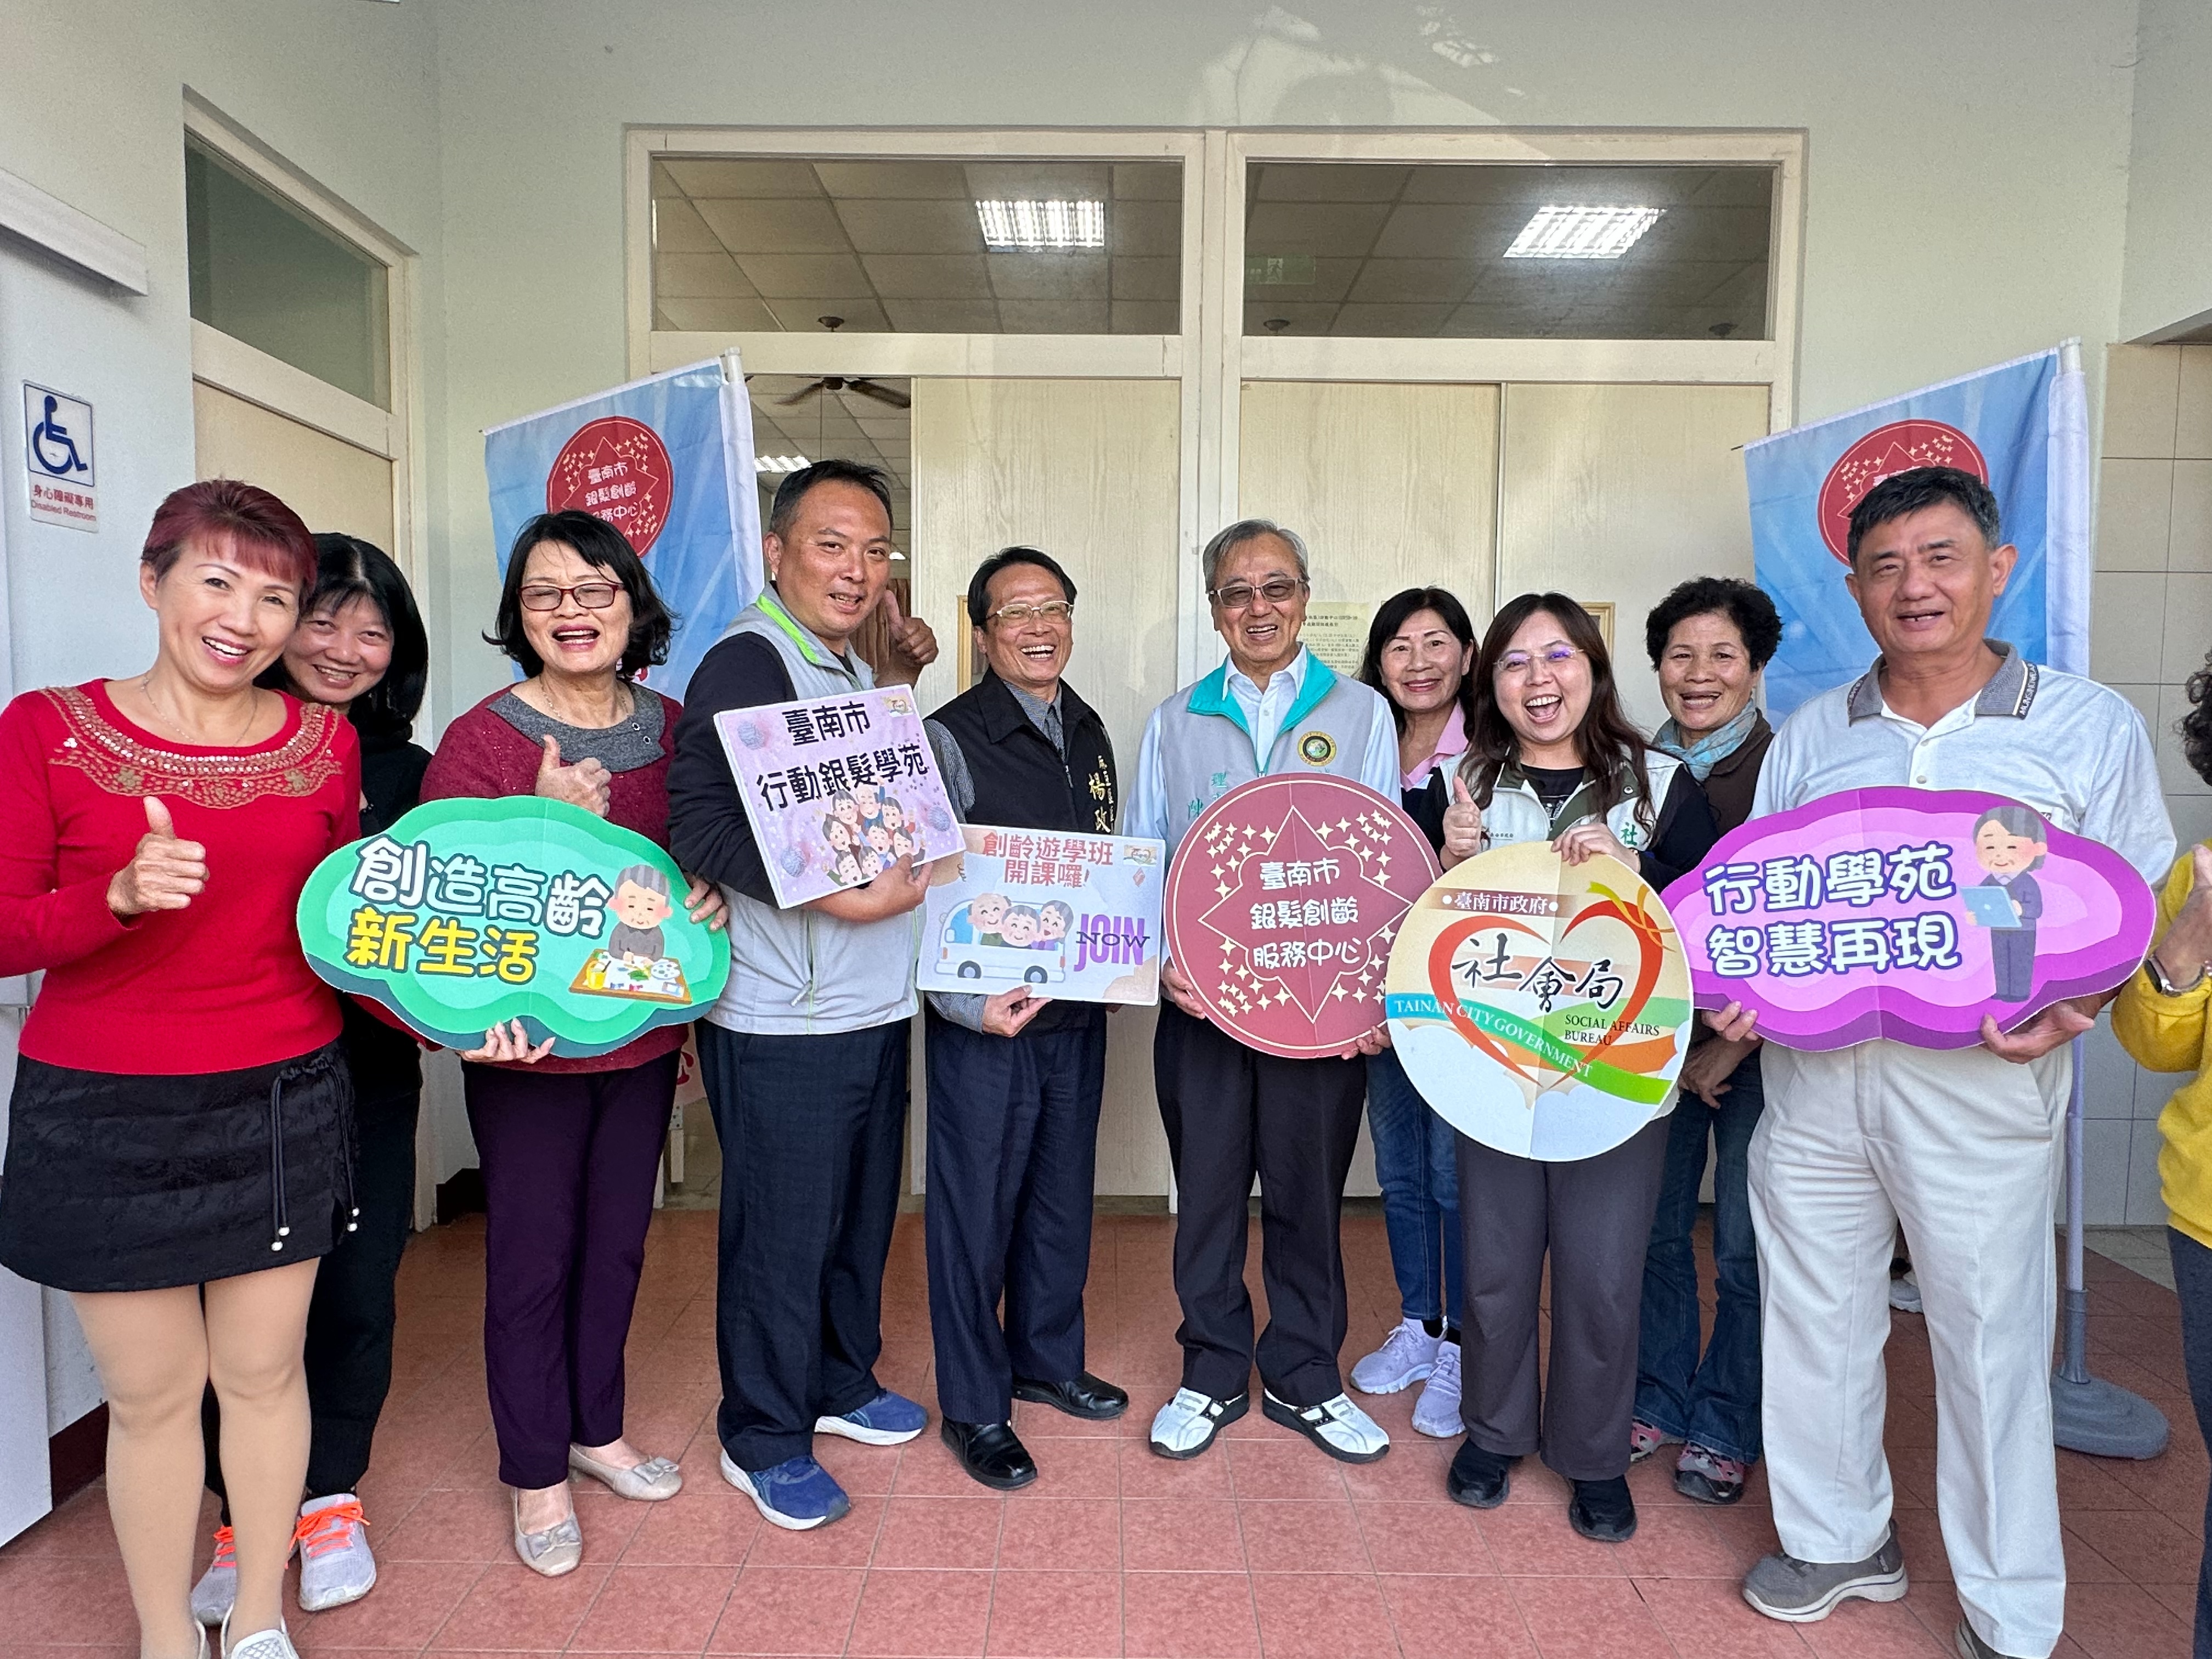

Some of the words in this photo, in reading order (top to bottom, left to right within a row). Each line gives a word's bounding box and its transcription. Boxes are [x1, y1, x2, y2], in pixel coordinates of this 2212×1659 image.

[588, 461, 628, 484] 臺南市
[585, 481, 636, 506] 銀髮創齡
[31, 500, 62, 514] Disabled
[63, 507, 97, 521] Restroom
[591, 501, 638, 522] 務中心
[782, 701, 871, 746] 臺南市
[756, 743, 929, 811] 行動銀髮學苑
[983, 832, 1114, 865] 創齡遊學班
[349, 835, 612, 938] 創造高齡
[1260, 857, 1340, 890] 臺南市
[1705, 842, 1956, 915] 行動學苑
[1250, 896, 1358, 930] 銀髮創齡
[1454, 891, 1548, 915] 臺南市政府
[346, 906, 540, 984] 新生活
[1074, 913, 1145, 972] JOIN
[1076, 931, 1150, 948] NOW
[1253, 938, 1362, 969] 服務中心
[1706, 913, 1961, 979] 智慧再現
[1452, 933, 1623, 1013] 社會局
[1394, 1000, 1454, 1015] TAINAN
[1456, 1003, 1493, 1025] CITY
[1494, 1013, 1593, 1077] GOVERNMENT
[1565, 1014, 1607, 1029] SOCIAL
[1611, 1020, 1660, 1036] AFFAIRS
[1565, 1029, 1612, 1046] BUREAU
